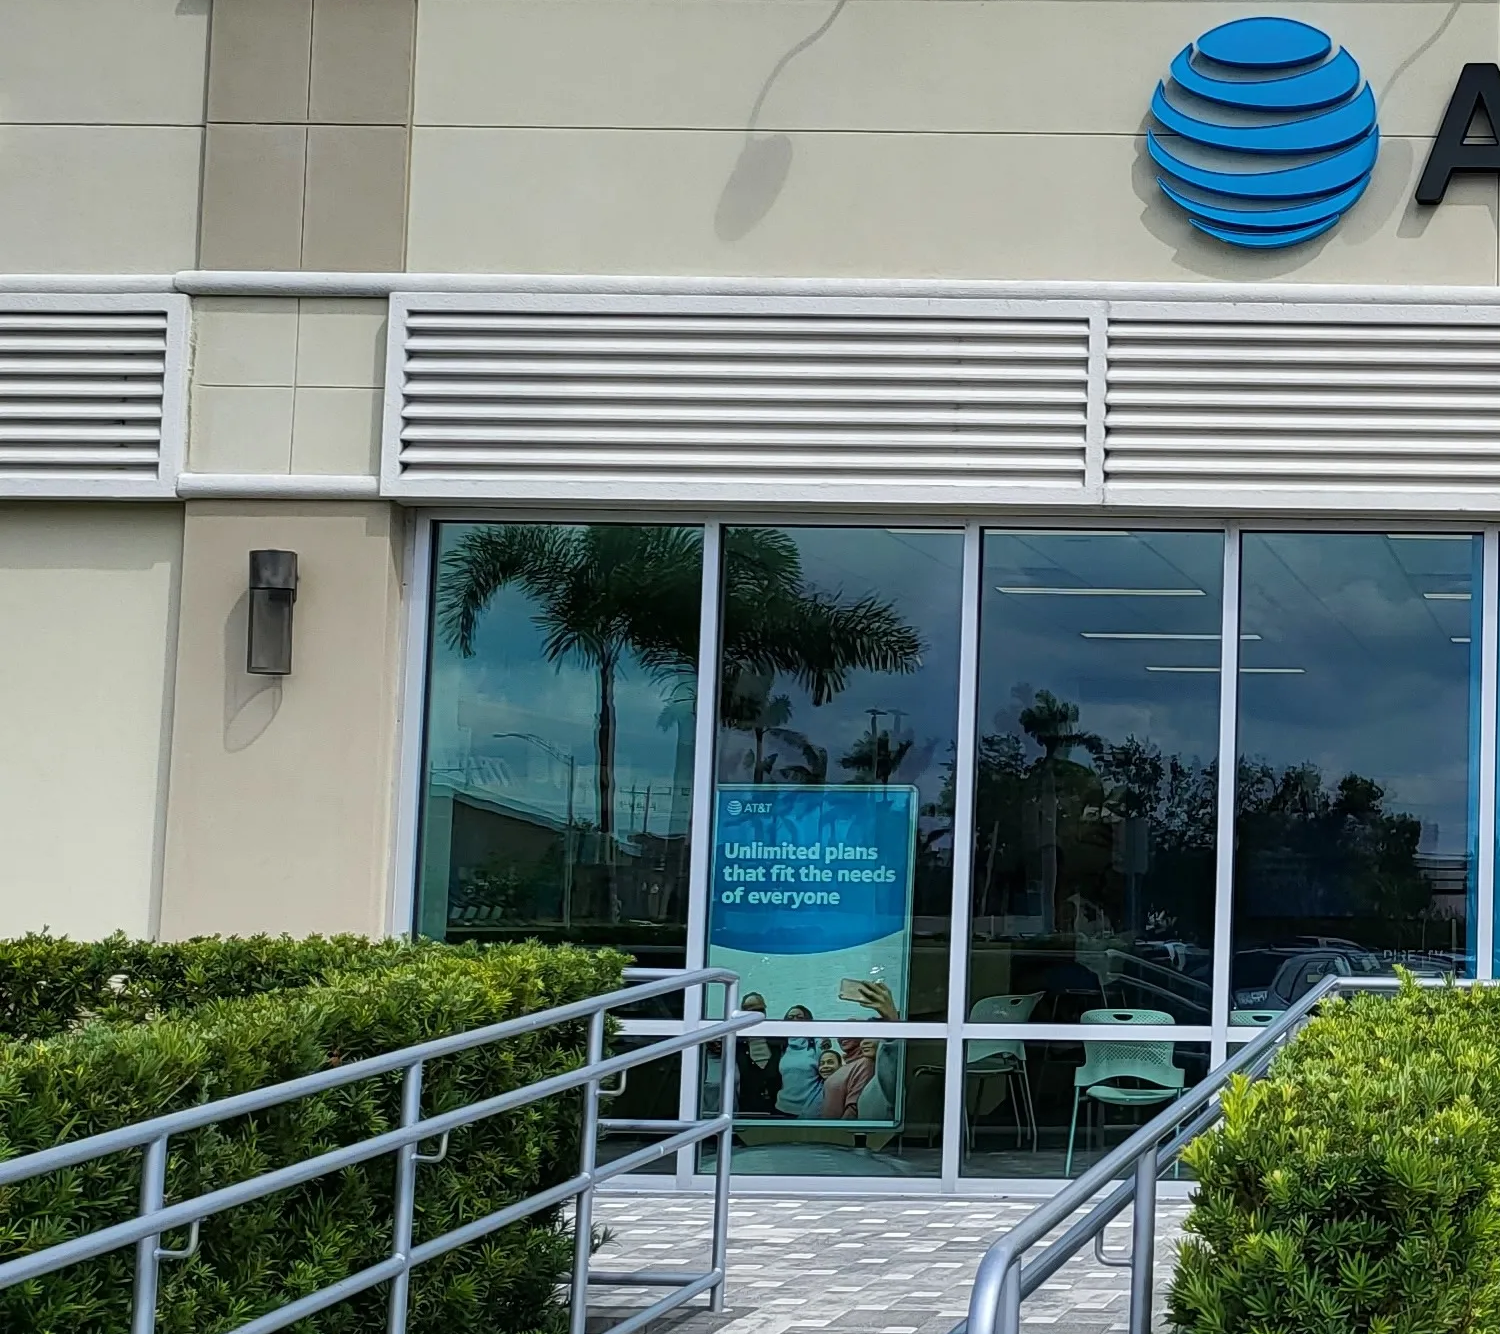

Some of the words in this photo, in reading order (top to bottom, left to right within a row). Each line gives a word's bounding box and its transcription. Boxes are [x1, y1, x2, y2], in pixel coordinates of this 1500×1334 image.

[744, 803, 772, 813] AT&T
[724, 842, 820, 860] Unlimited
[825, 843, 878, 864] plans
[723, 865, 766, 882] that
[770, 865, 795, 882] fit
[799, 865, 833, 882] the
[837, 866, 896, 883] needs
[721, 887, 744, 904] of
[748, 890, 840, 909] everyone
